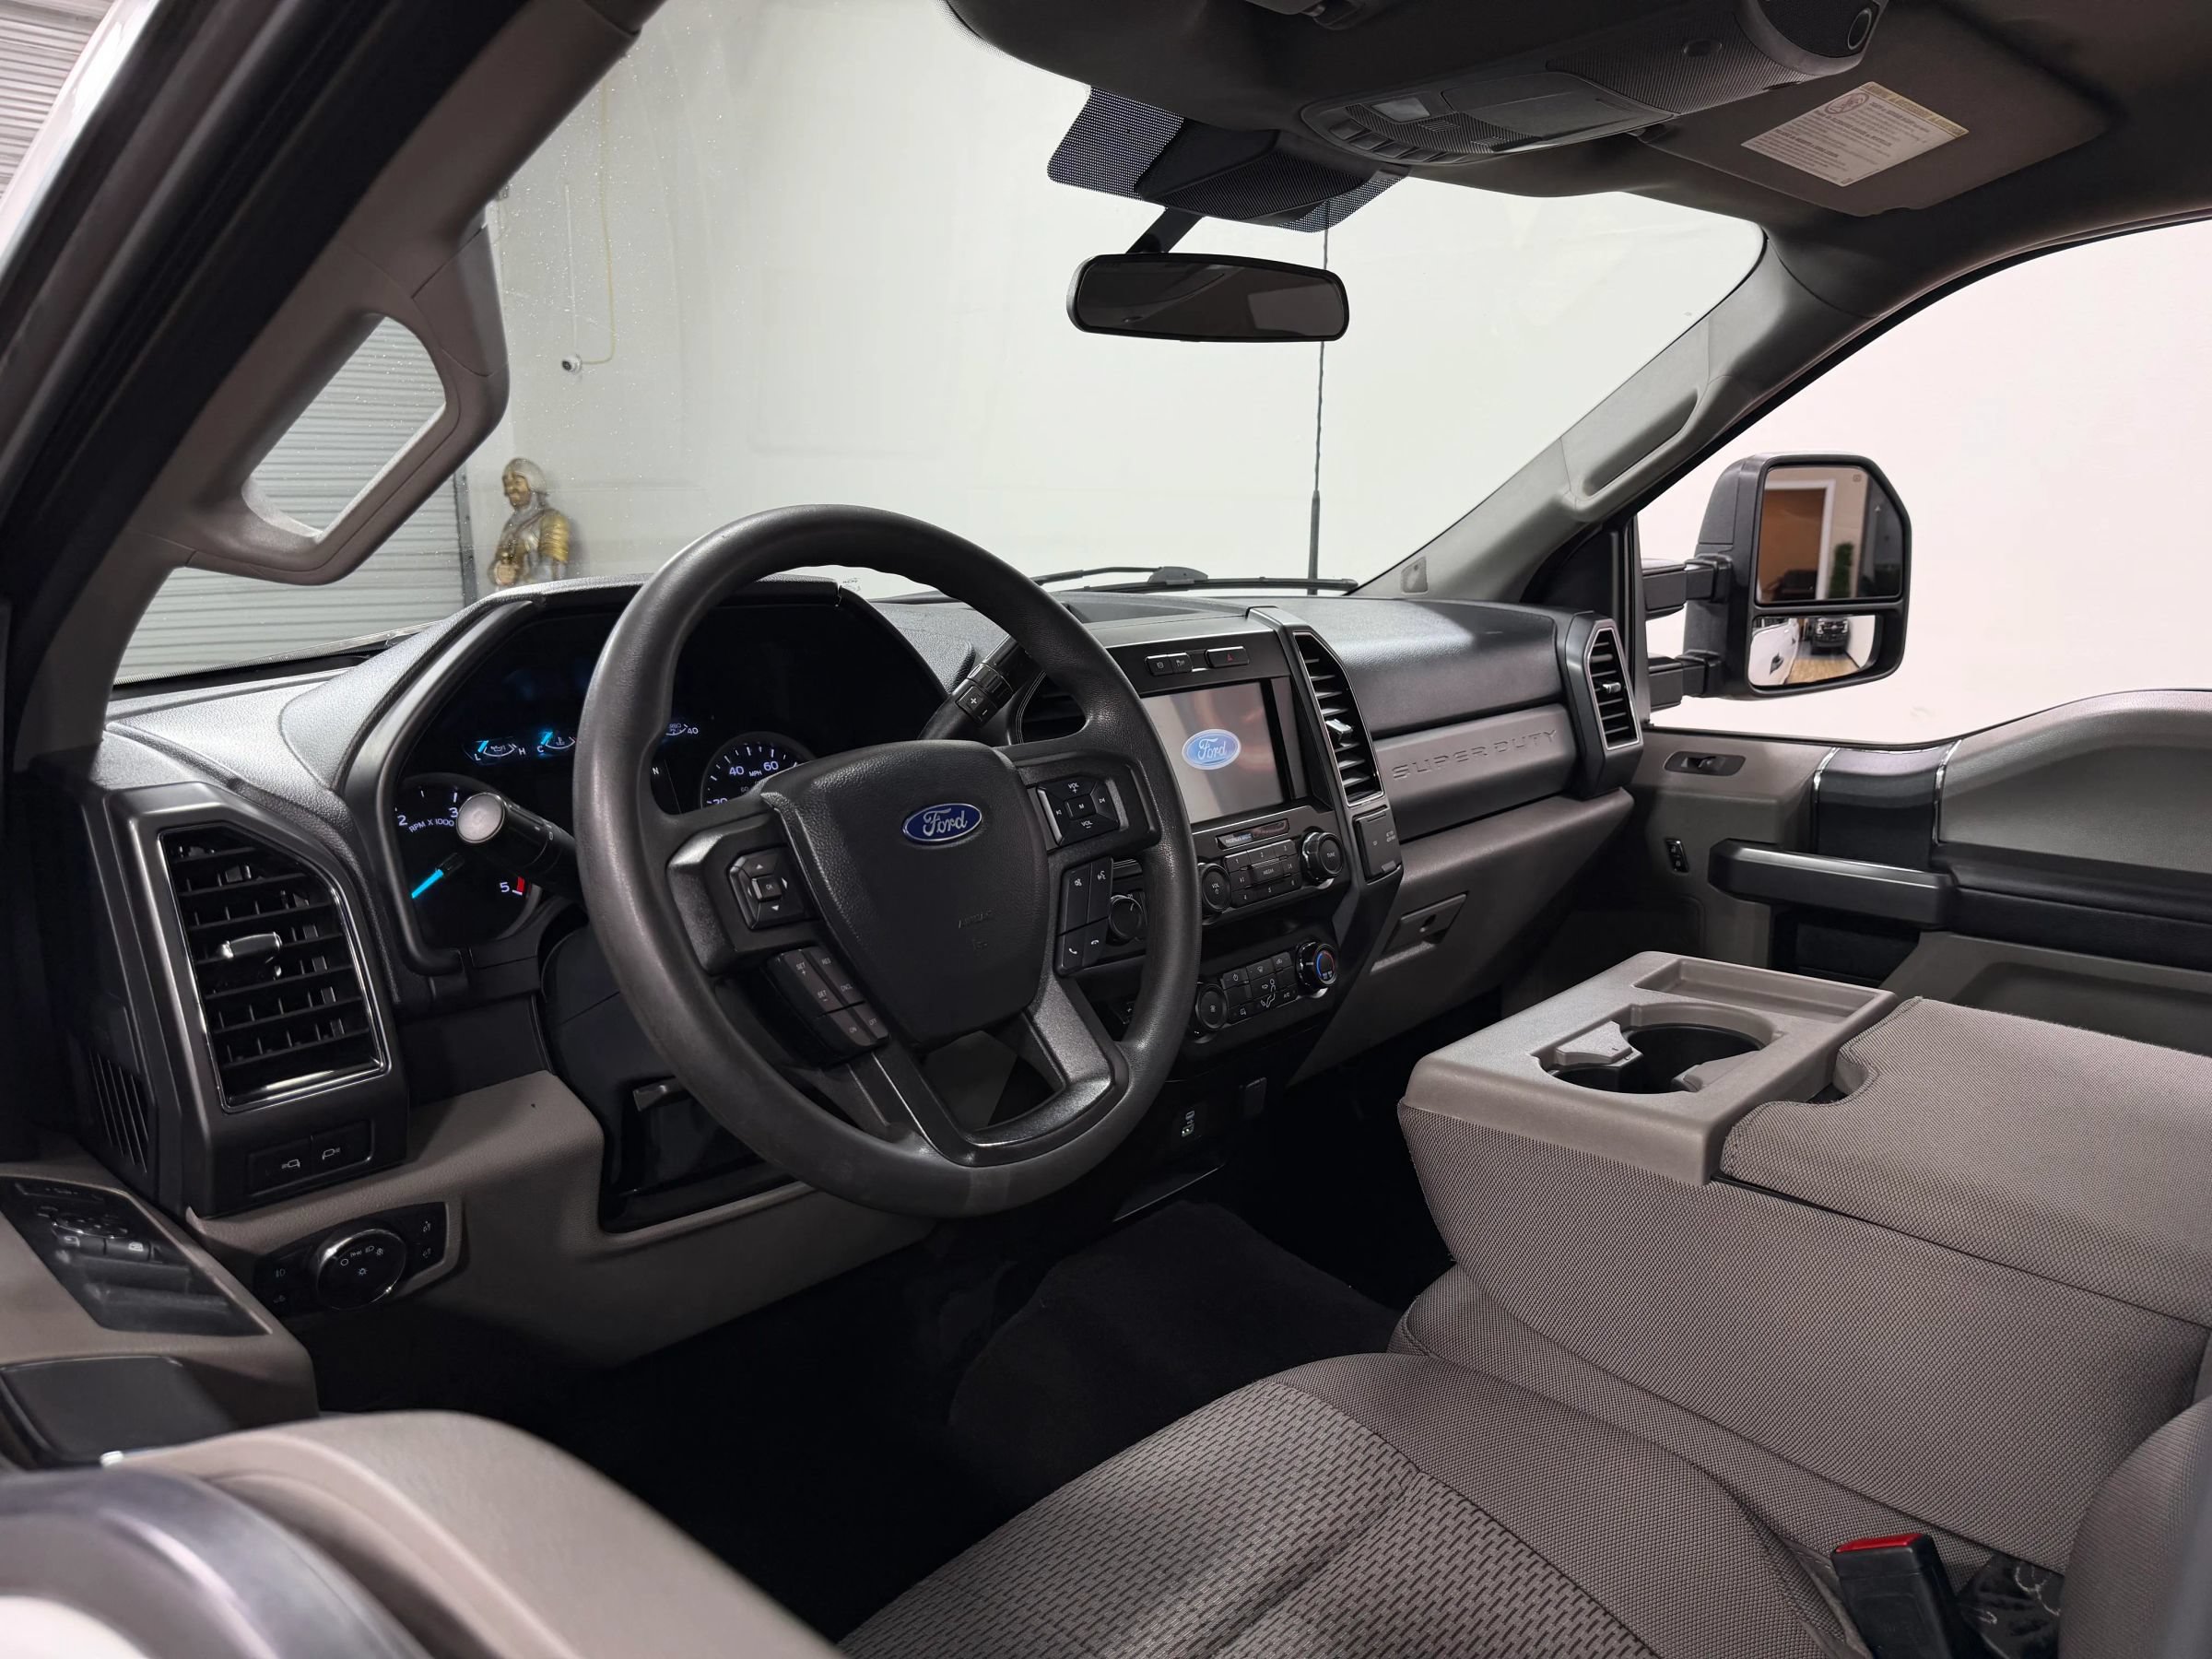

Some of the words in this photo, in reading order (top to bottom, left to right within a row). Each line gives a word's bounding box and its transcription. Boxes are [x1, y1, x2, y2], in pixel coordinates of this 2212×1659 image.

[687, 726, 699, 735] 40
[518, 747, 526, 756] H
[1197, 737, 1227, 759] Ford
[1392, 746, 1488, 780] SUPER
[1493, 729, 1557, 753] DUTY
[652, 767, 660, 775] N
[729, 765, 745, 776] 40
[763, 760, 779, 771] 60
[448, 806, 459, 818] 3
[396, 815, 408, 827] 2
[408, 820, 426, 833] RPM
[435, 818, 455, 827] 1000
[923, 807, 968, 837] Ford
[500, 881, 510, 893] 5
